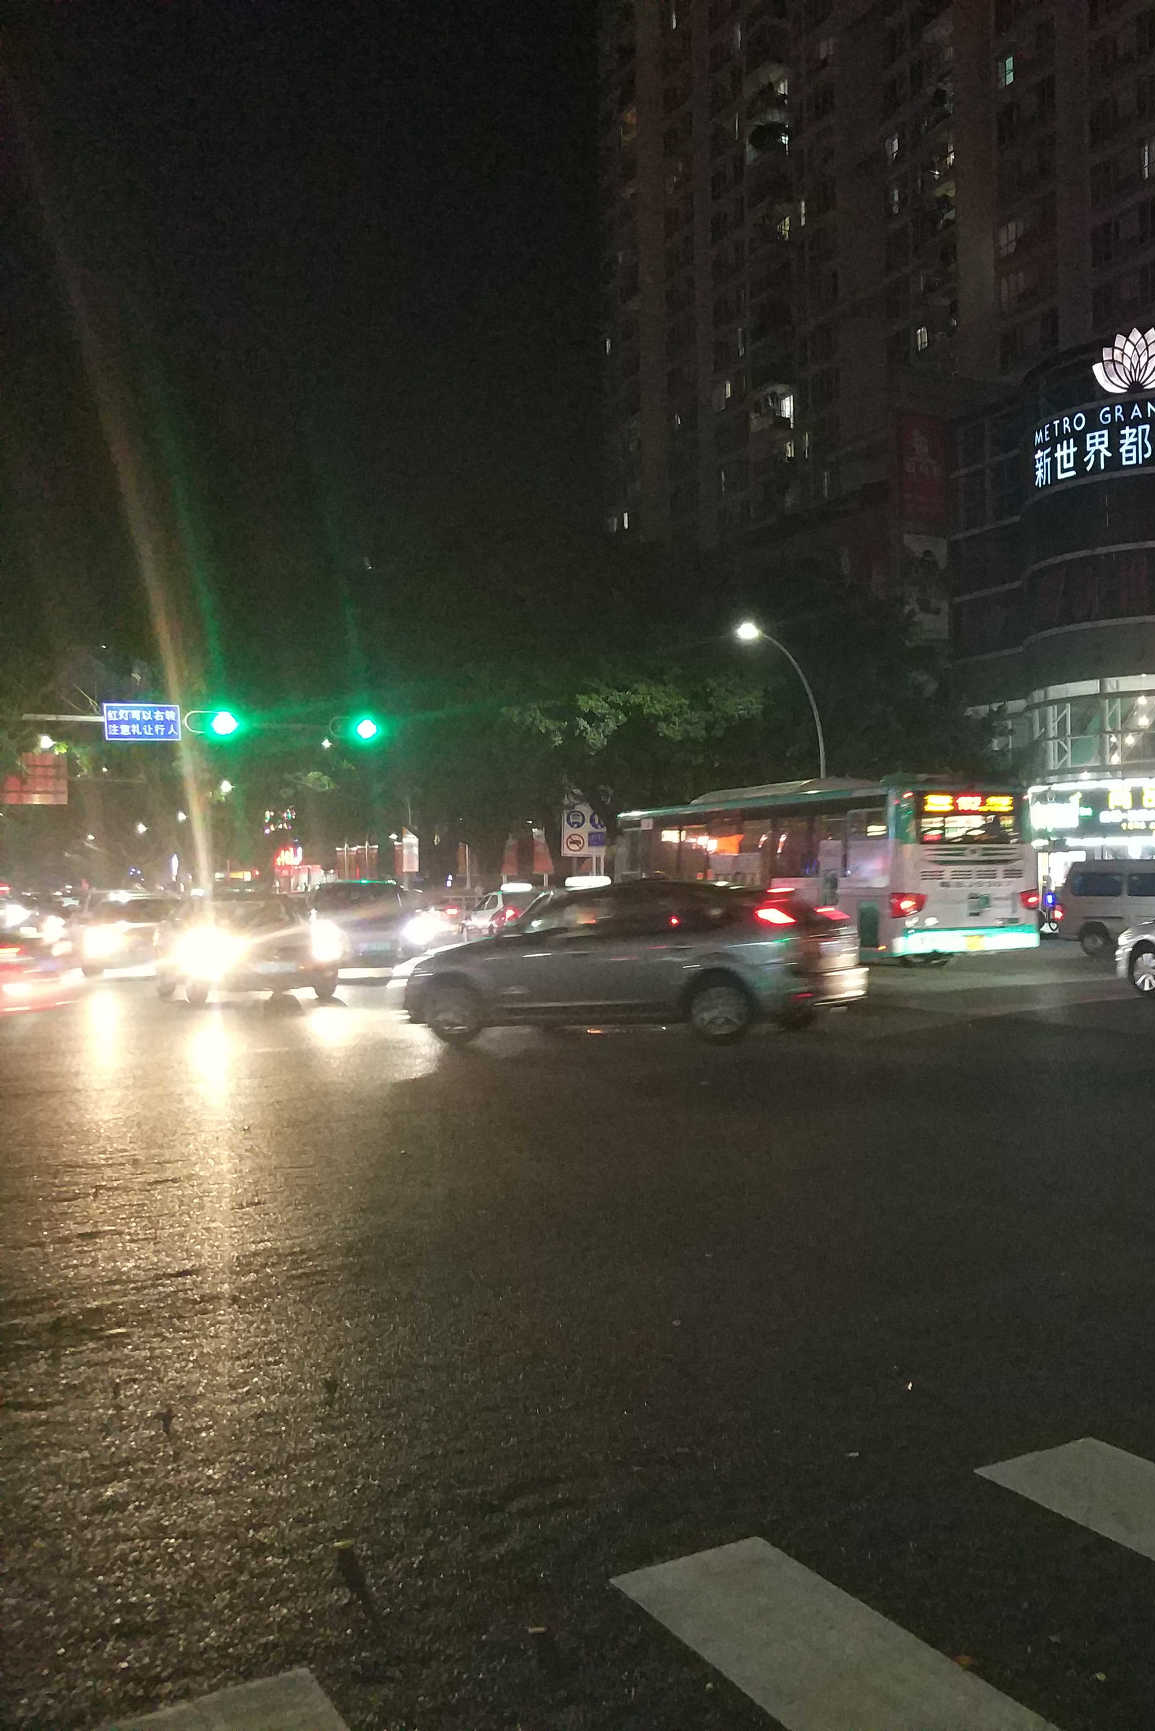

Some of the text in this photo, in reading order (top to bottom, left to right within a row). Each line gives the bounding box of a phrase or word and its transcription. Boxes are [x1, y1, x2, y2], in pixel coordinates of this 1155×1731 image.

[1034, 412, 1086, 447] METRO
[107, 709, 177, 721] 红灯可以右转
[108, 723, 178, 736] 注意礼让行人
